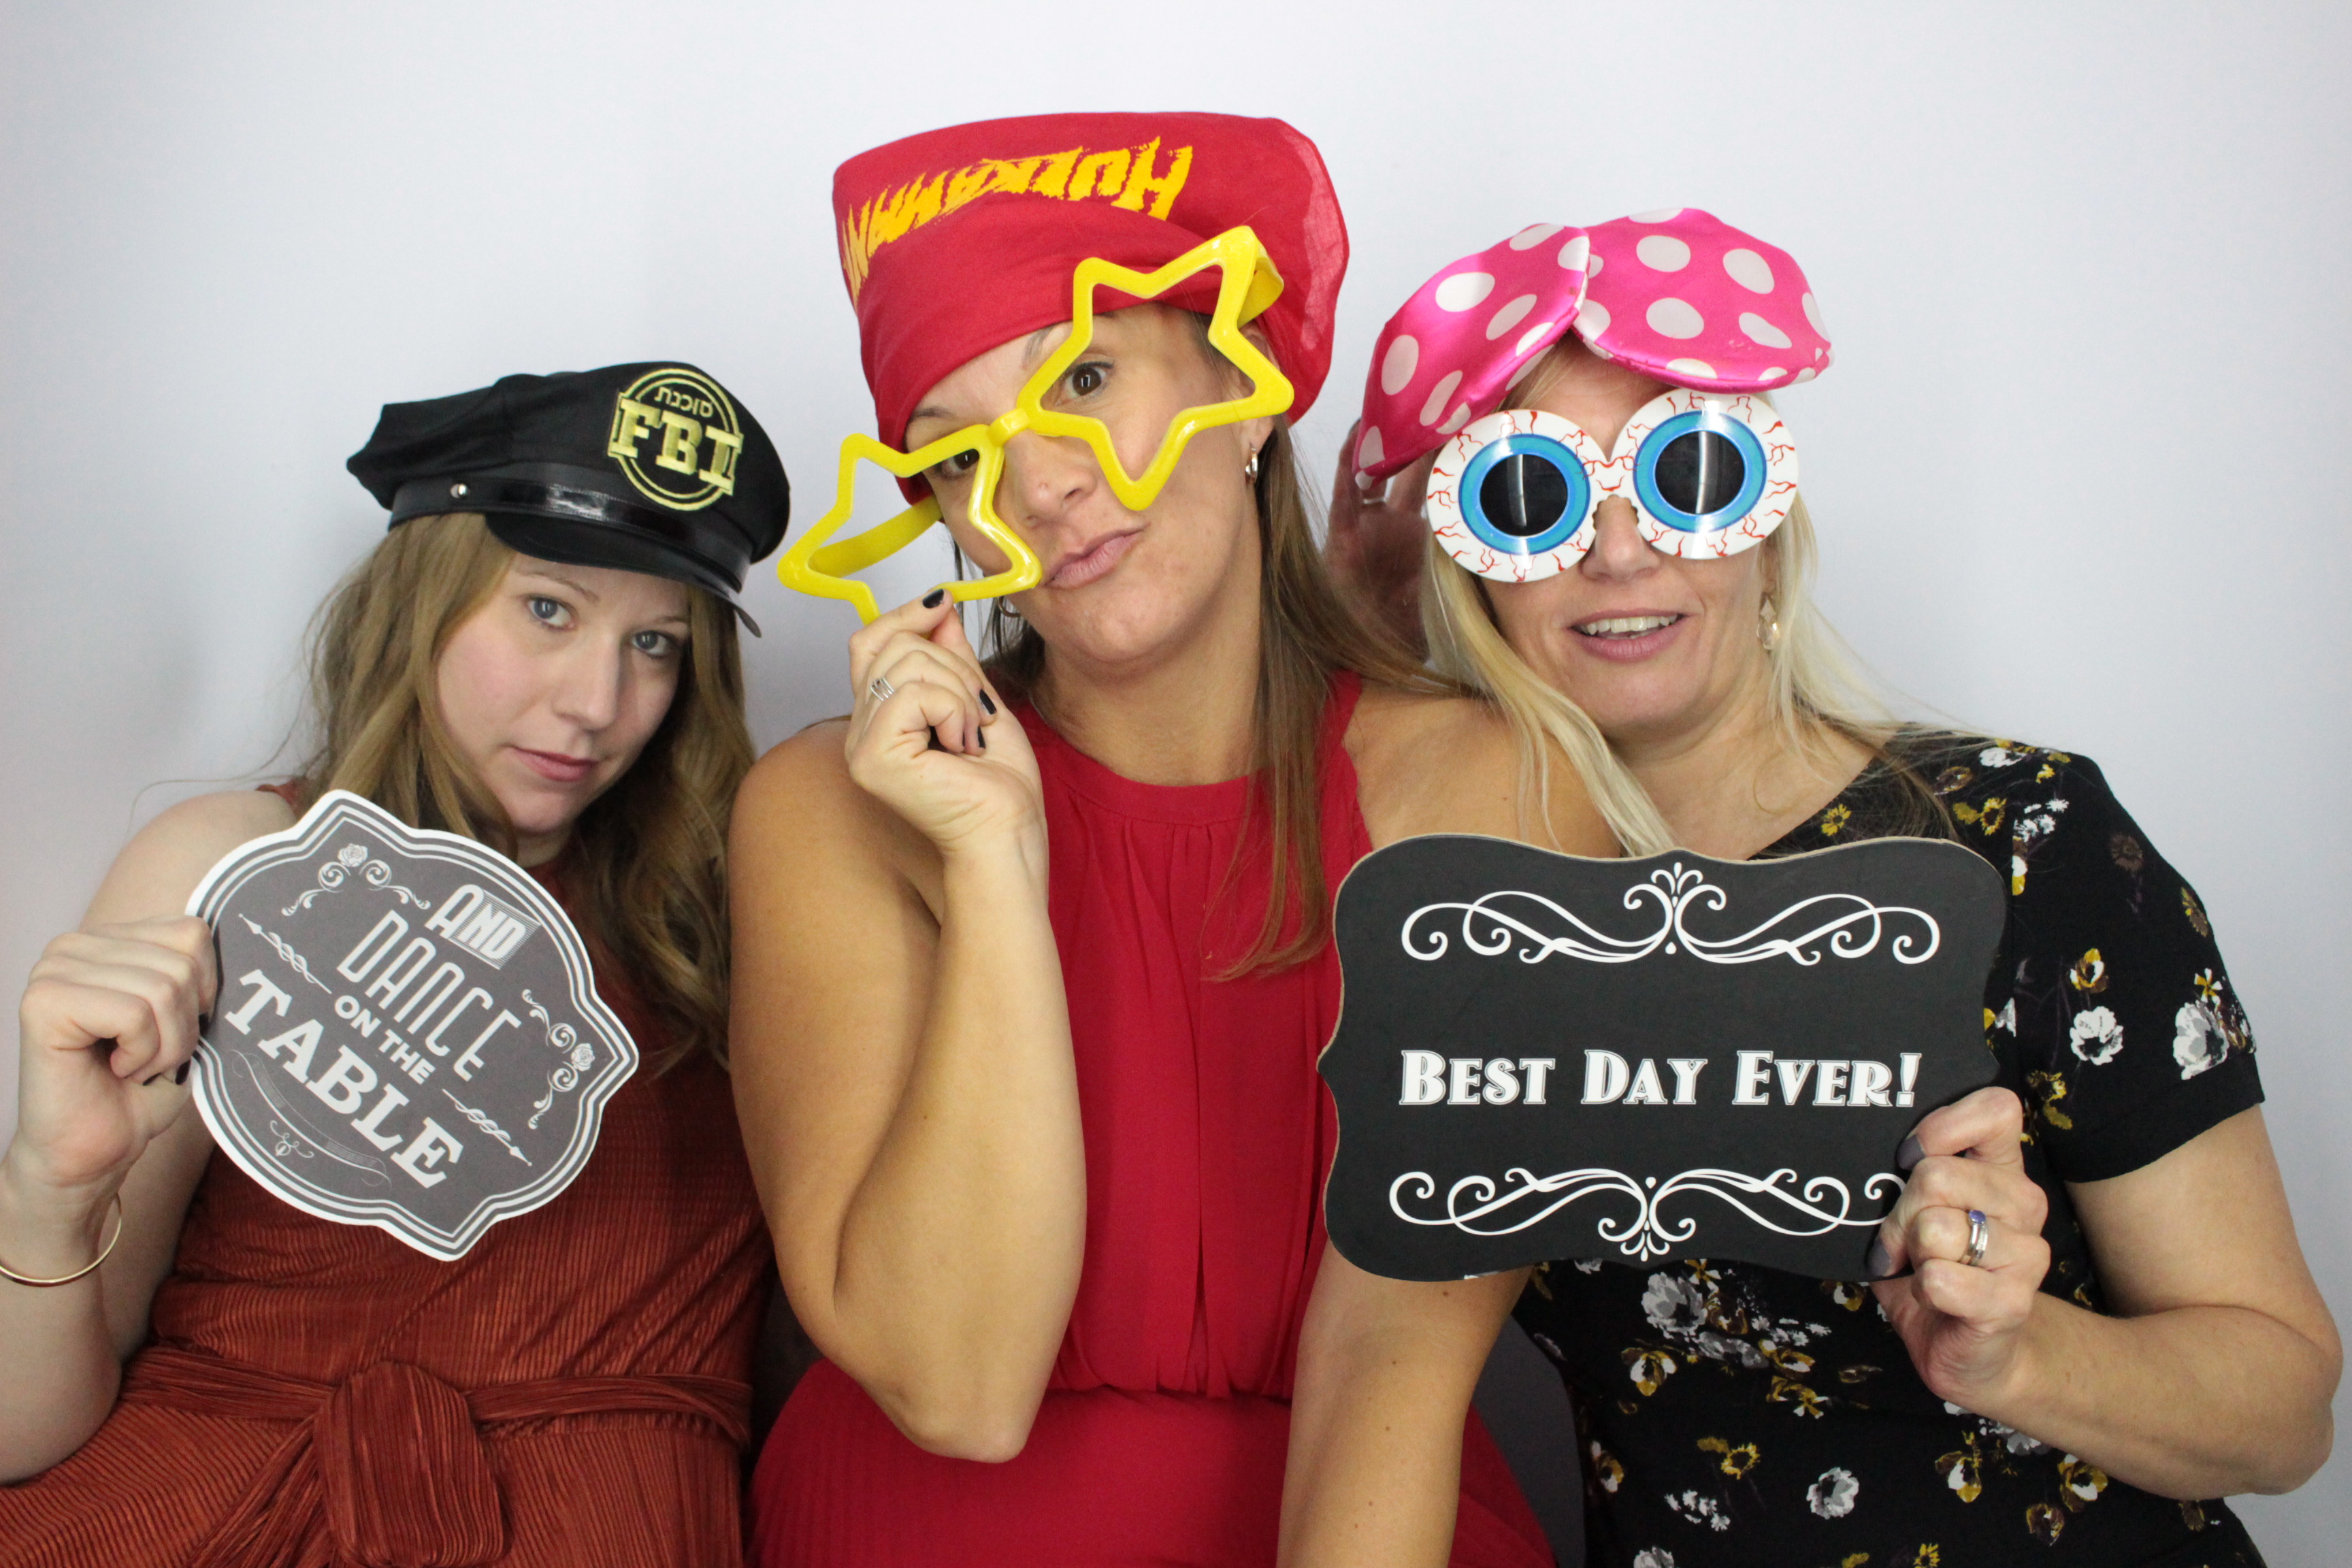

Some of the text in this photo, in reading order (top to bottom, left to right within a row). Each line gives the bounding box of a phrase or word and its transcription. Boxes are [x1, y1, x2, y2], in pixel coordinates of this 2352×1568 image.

[611, 397, 743, 494] FBI
[654, 386, 714, 419] סוכנת
[424, 883, 529, 960] AND
[334, 995, 436, 1085] ON THE
[336, 909, 522, 1082] DANCE
[224, 969, 464, 1189] TABLE
[1399, 1049, 1556, 1107] BEST
[1581, 1049, 1708, 1106] DAY
